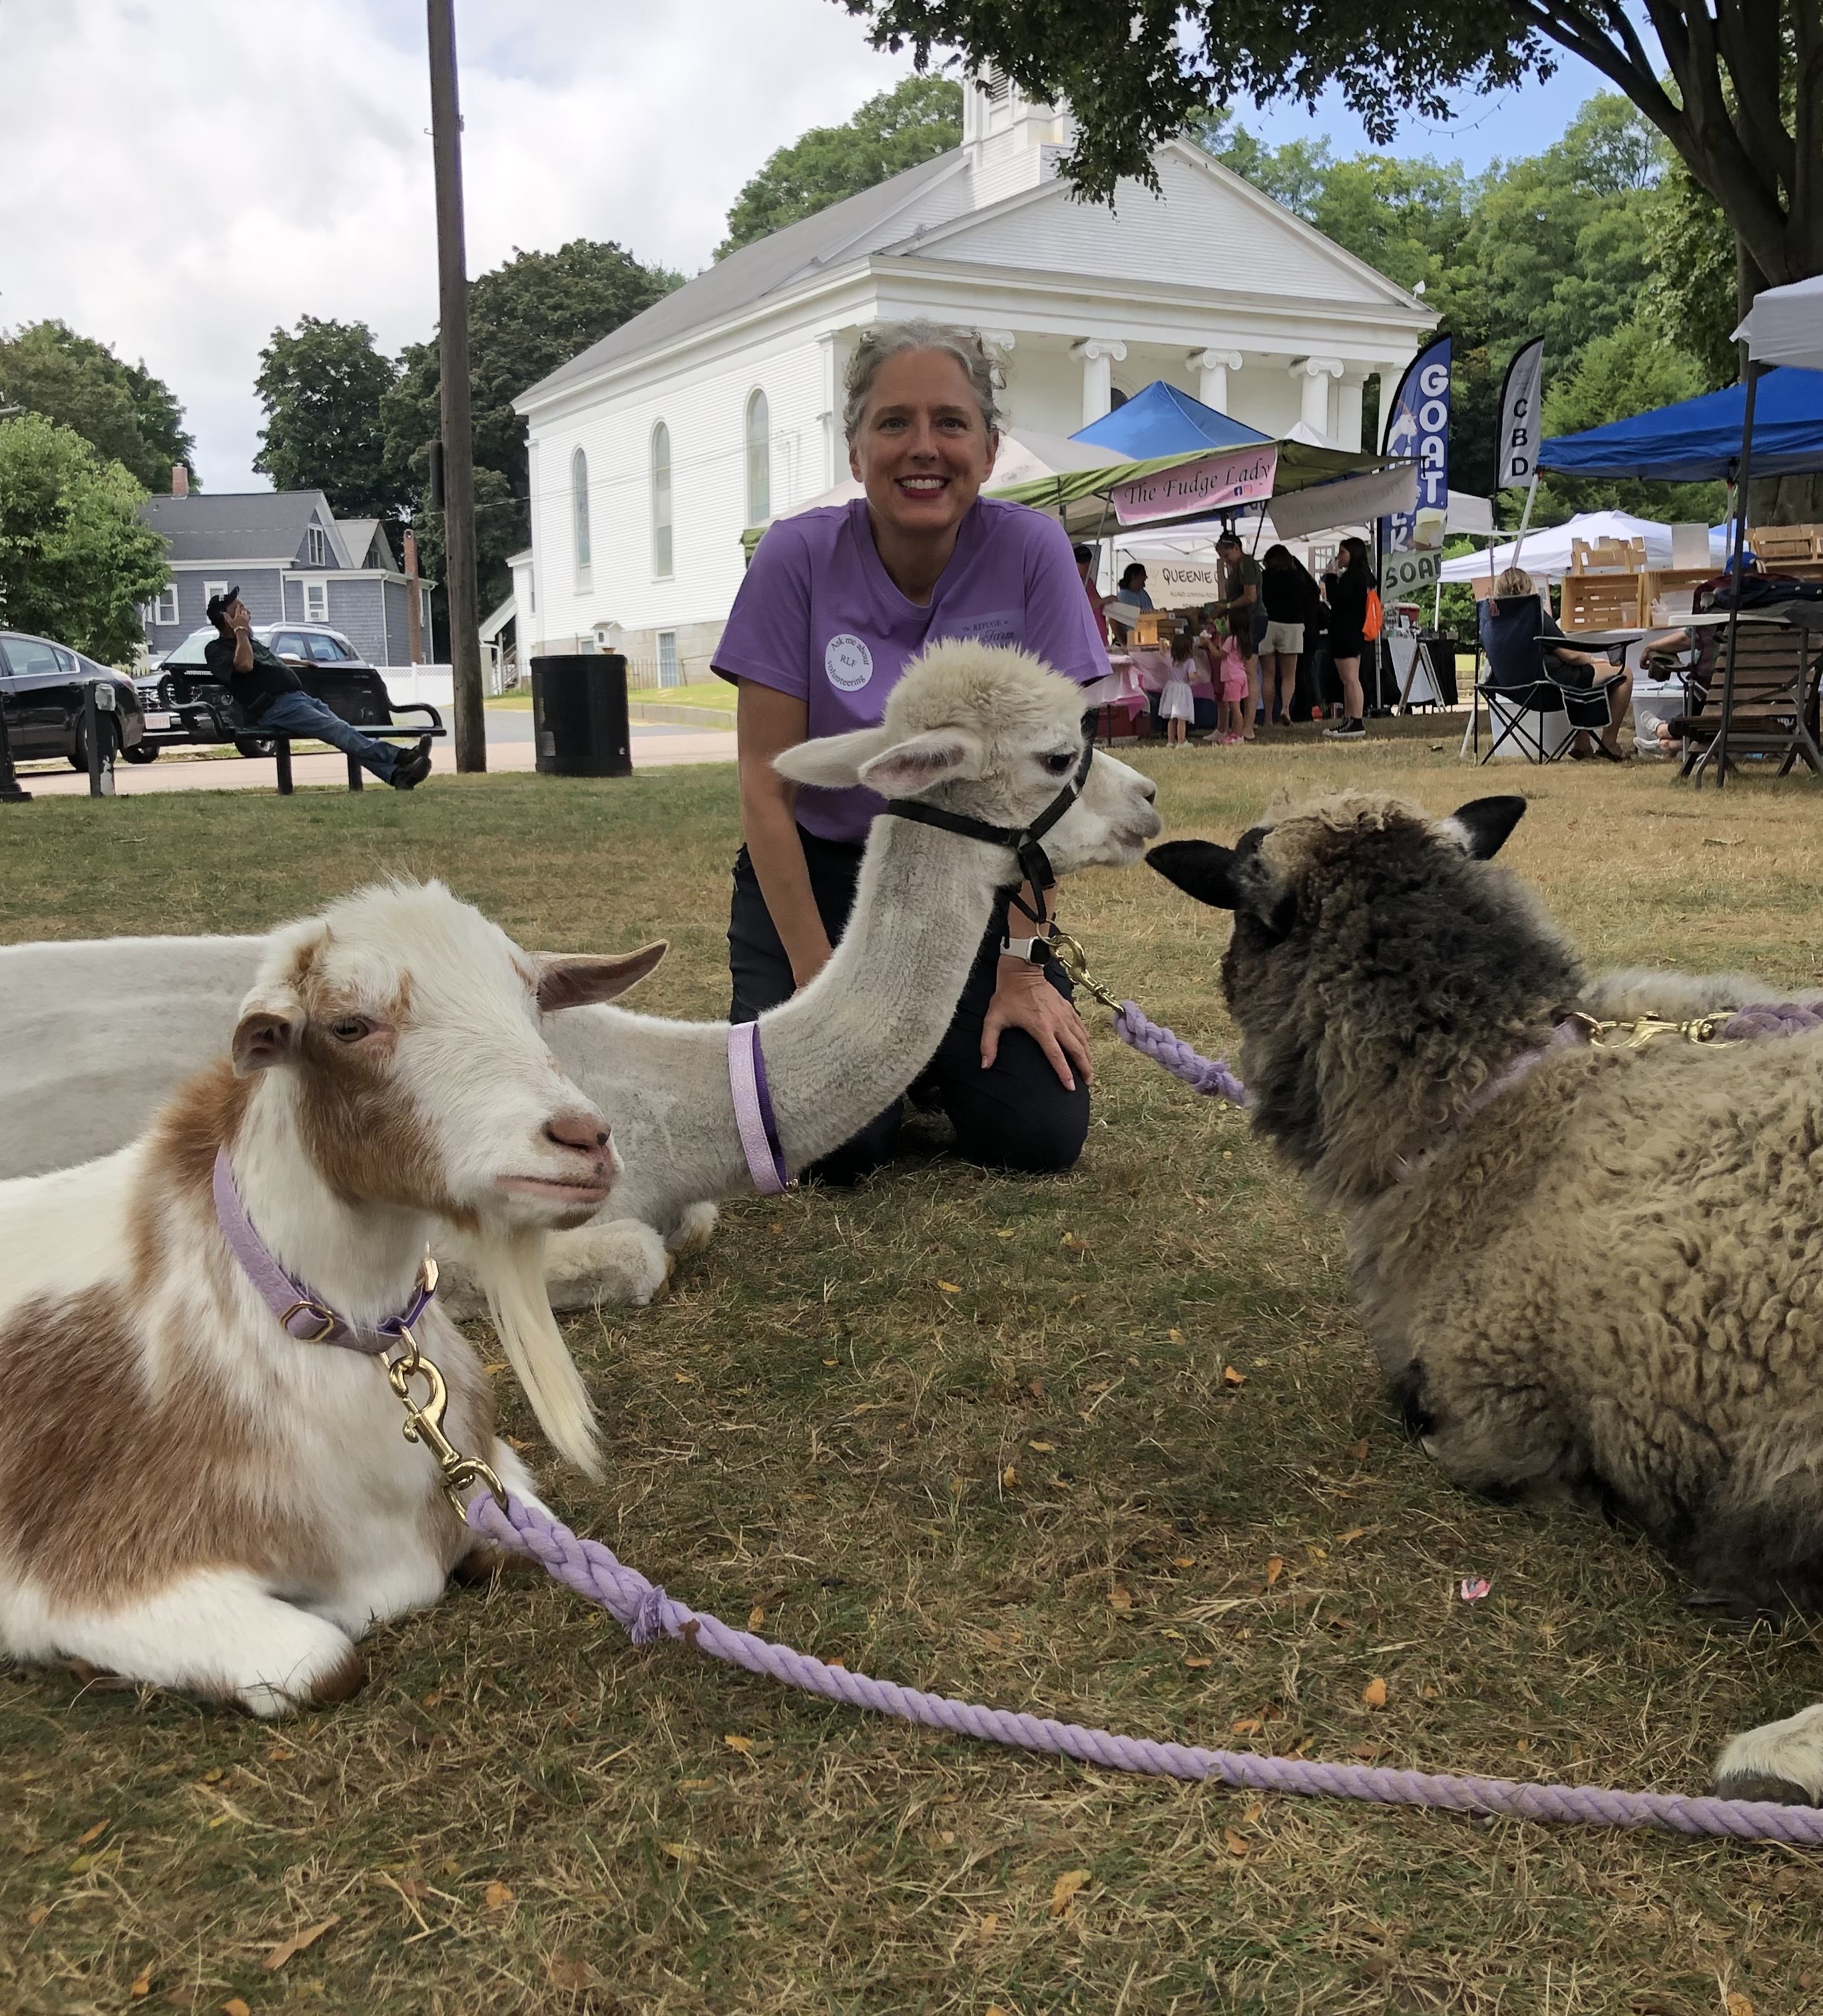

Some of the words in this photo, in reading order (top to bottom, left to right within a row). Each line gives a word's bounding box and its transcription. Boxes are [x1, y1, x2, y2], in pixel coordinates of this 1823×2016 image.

[1420, 364, 1449, 503] GOAT
[1511, 399, 1529, 477] CBD
[1124, 482, 1157, 504] The
[1163, 471, 1218, 498] Fudge
[1225, 457, 1270, 485] Lady
[1162, 567, 1212, 585] QUEENIE
[973, 620, 1001, 631] REFUGE
[985, 629, 1014, 642] Farm
[831, 636, 845, 651] Ask
[856, 644, 870, 665] about
[840, 654, 858, 667] RLF
[827, 660, 866, 687] volunteering
